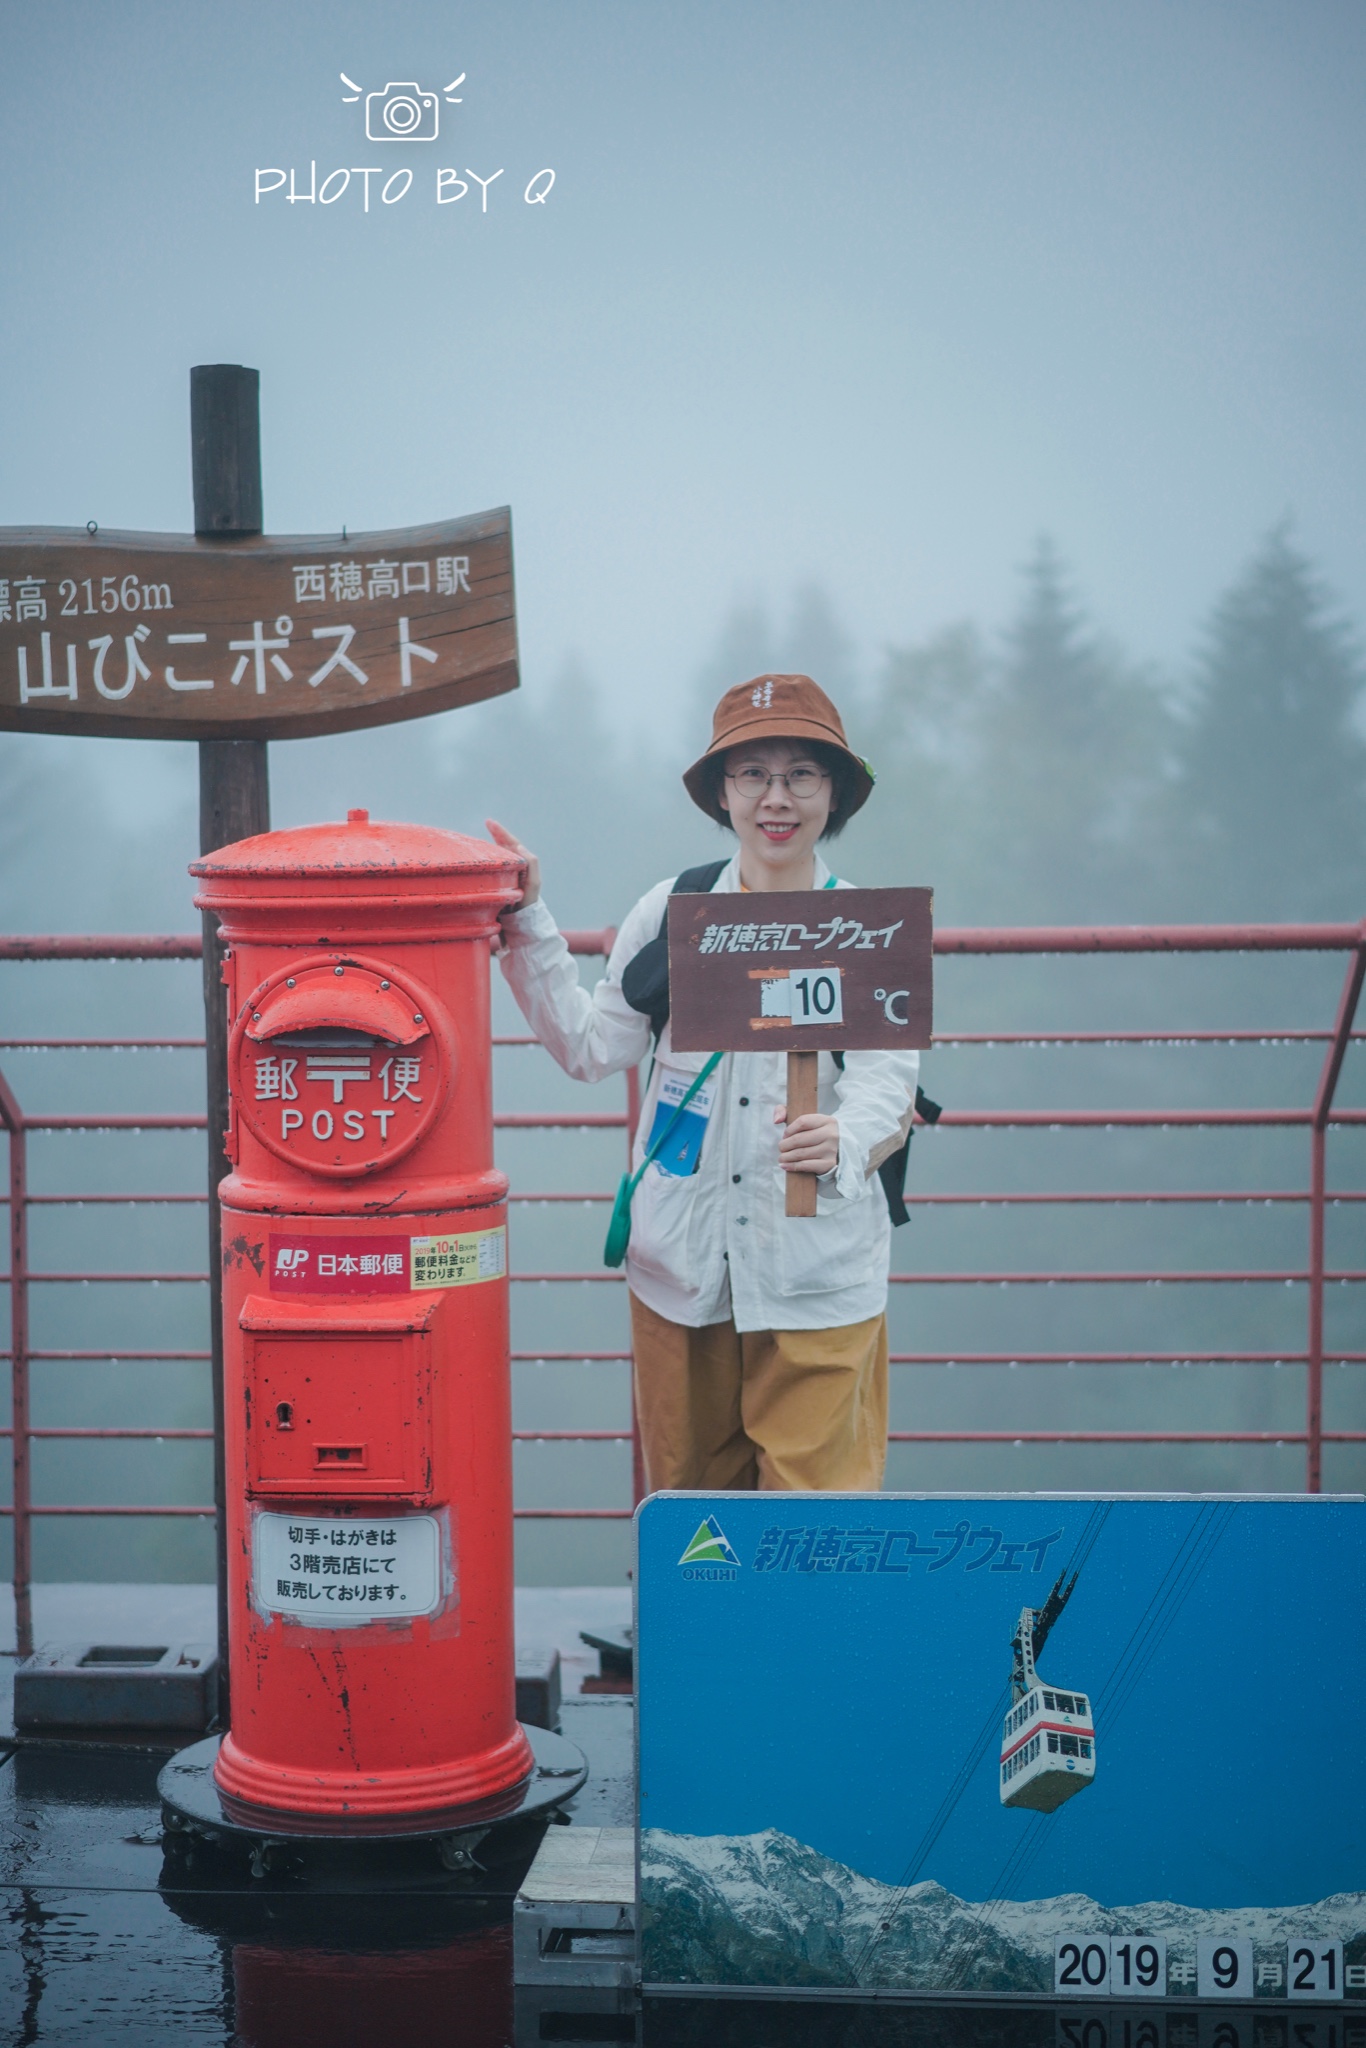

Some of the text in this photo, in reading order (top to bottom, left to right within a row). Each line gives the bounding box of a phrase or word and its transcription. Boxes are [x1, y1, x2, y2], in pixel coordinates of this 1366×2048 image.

[292, 556, 472, 604] 西穂高口駅
[58, 574, 174, 617] 2156m
[17, 615, 438, 704] 山びこポスト
[795, 976, 836, 1016] 10
[281, 1108, 395, 1141] POST
[274, 1270, 307, 1278] POST
[317, 1253, 404, 1276] 日本郵便
[288, 1526, 397, 1546] 切手・はがきは
[289, 1553, 397, 1575] 3階売店にて
[682, 1568, 737, 1582] OKUHI
[277, 1579, 407, 1601] 販売しております。
